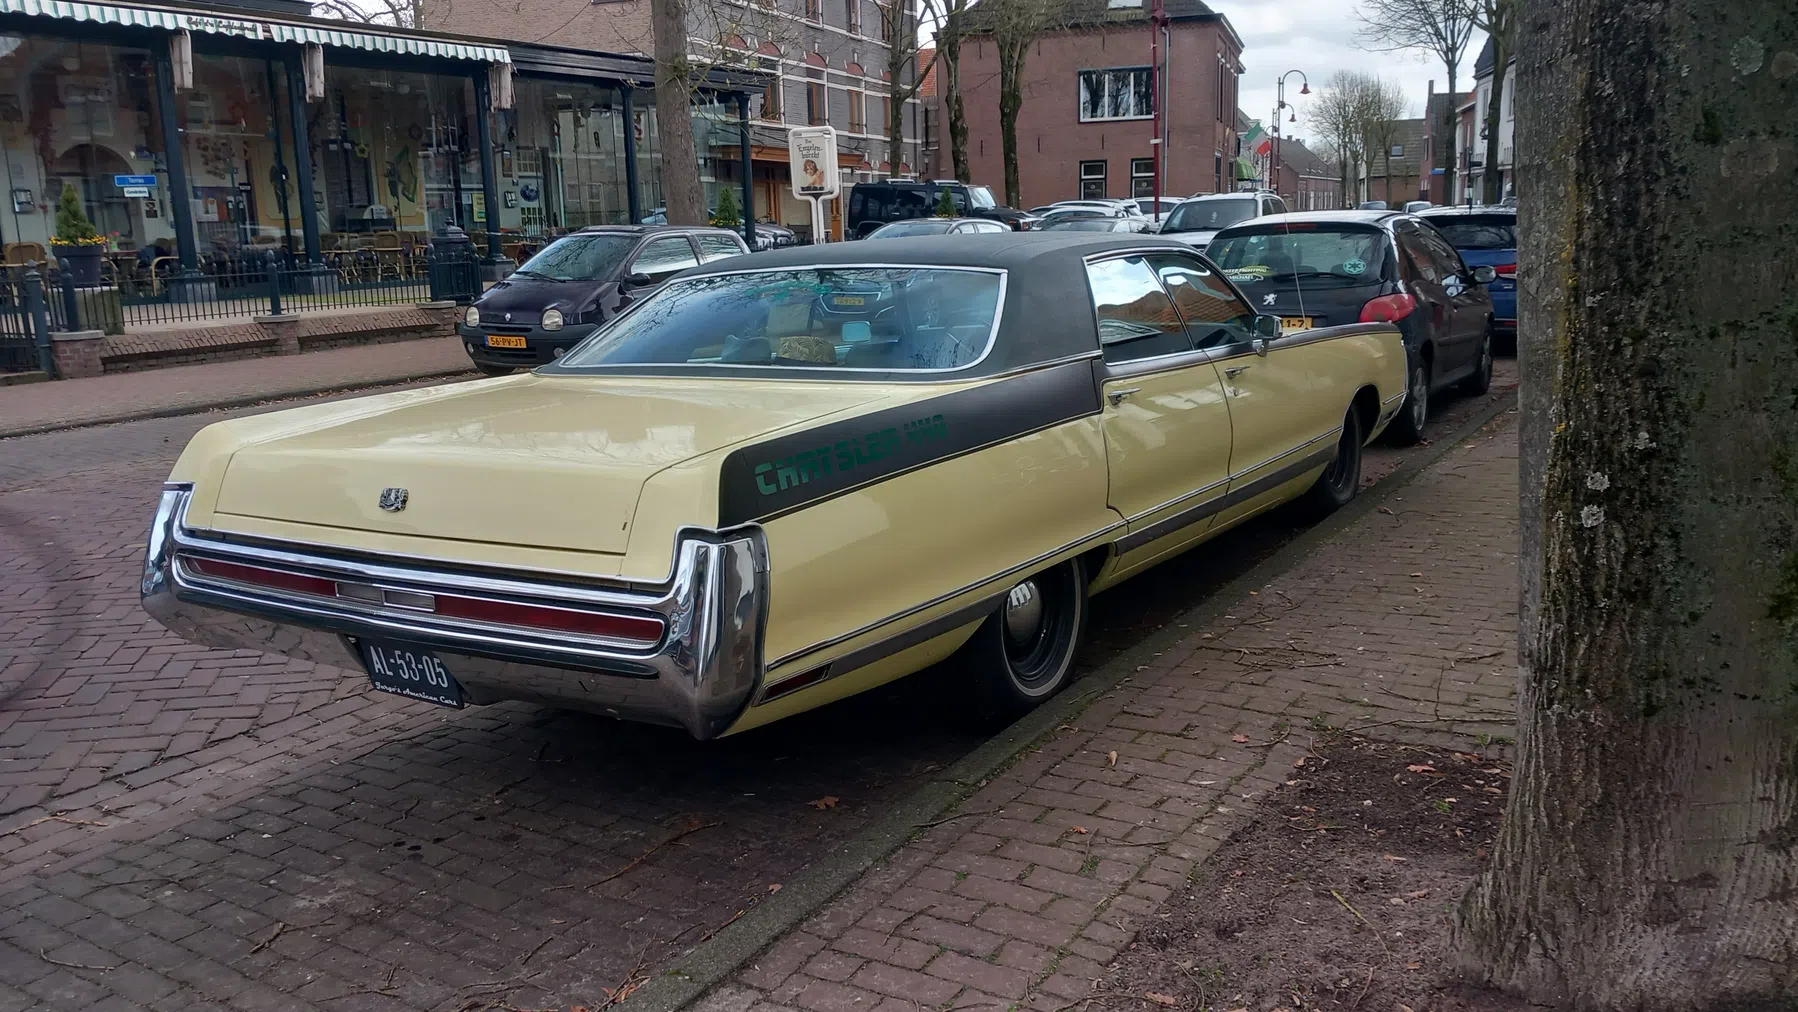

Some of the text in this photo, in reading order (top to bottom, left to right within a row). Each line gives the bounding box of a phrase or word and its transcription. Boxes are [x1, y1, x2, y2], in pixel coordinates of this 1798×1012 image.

[490, 337, 524, 347] 56-PV-JT
[369, 645, 449, 688] AL-53-05
[402, 687, 439, 702] American
[439, 695, 458, 706] Cars
